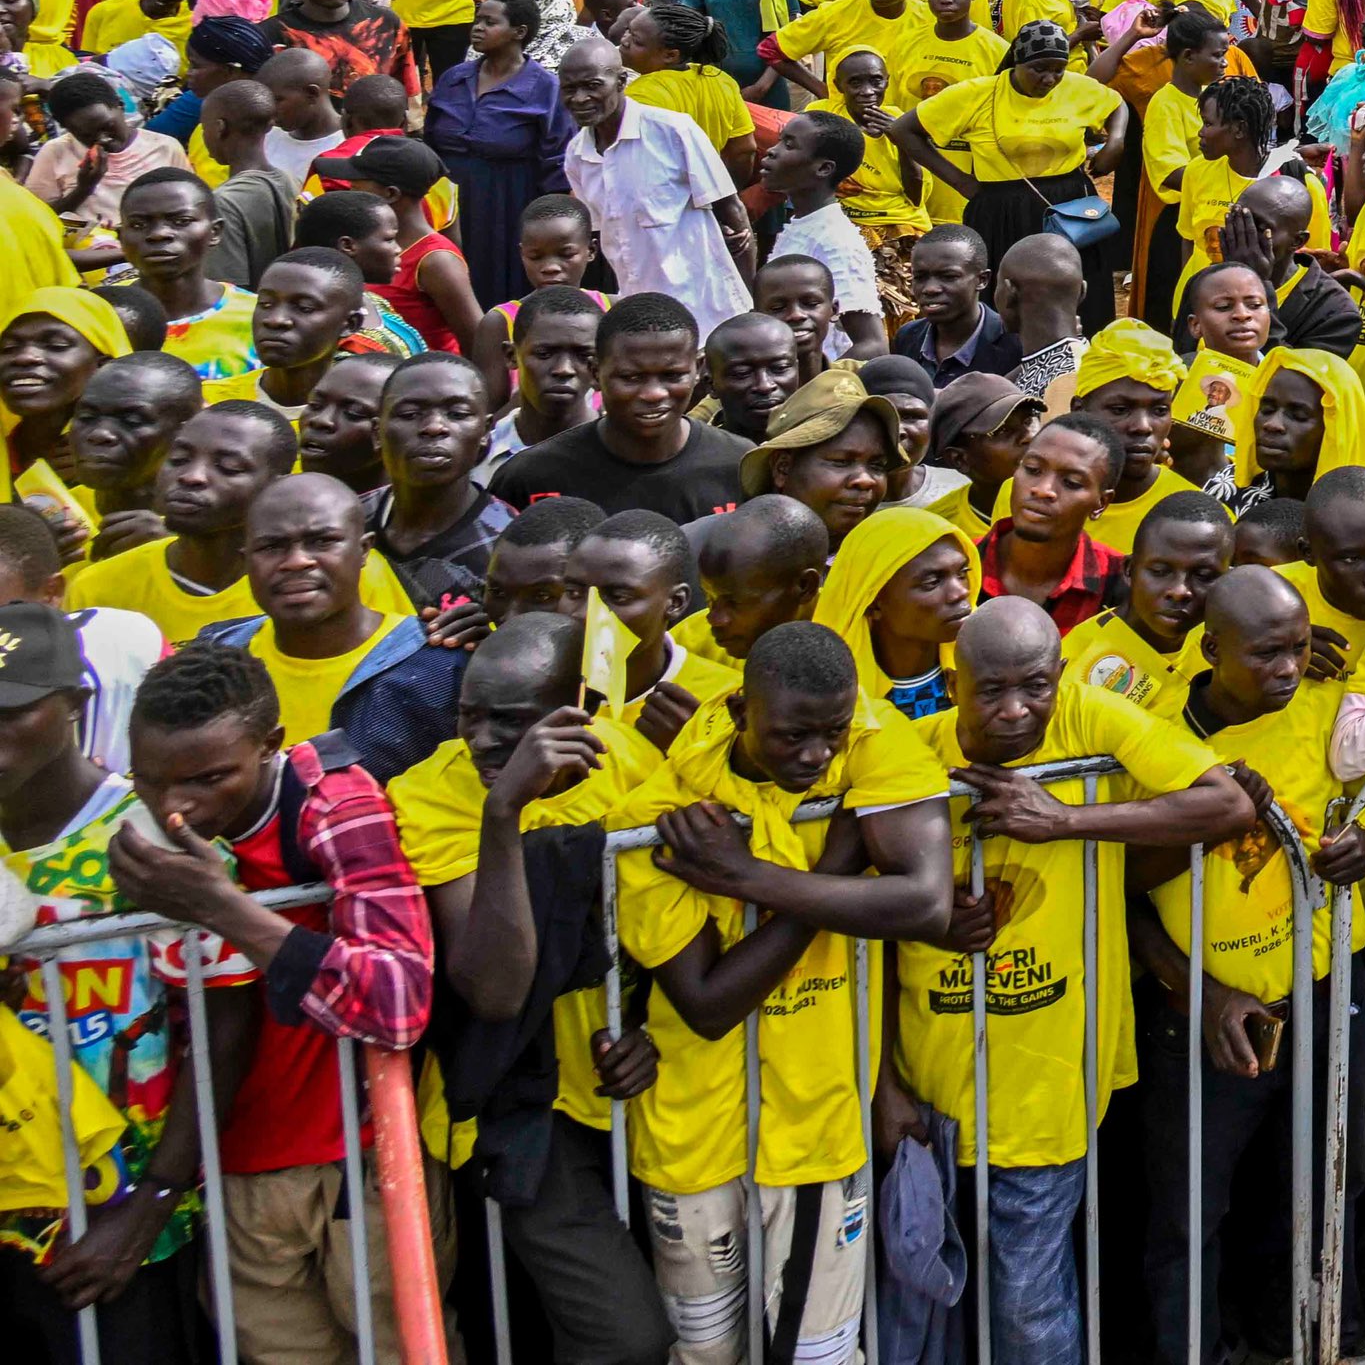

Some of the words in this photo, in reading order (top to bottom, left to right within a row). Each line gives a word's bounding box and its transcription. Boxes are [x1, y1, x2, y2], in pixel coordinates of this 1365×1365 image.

[934, 55, 969, 67] PRESIDENT
[1218, 362, 1251, 379] PRESIDENT
[1187, 415, 1227, 435] MUSEVENI
[1195, 409, 1225, 426] YOWERI
[1211, 932, 1262, 953] YOWERI
[938, 961, 1052, 992] MUEVENI
[998, 993, 1017, 1007] THE
[1020, 987, 1055, 1004] GAINS
